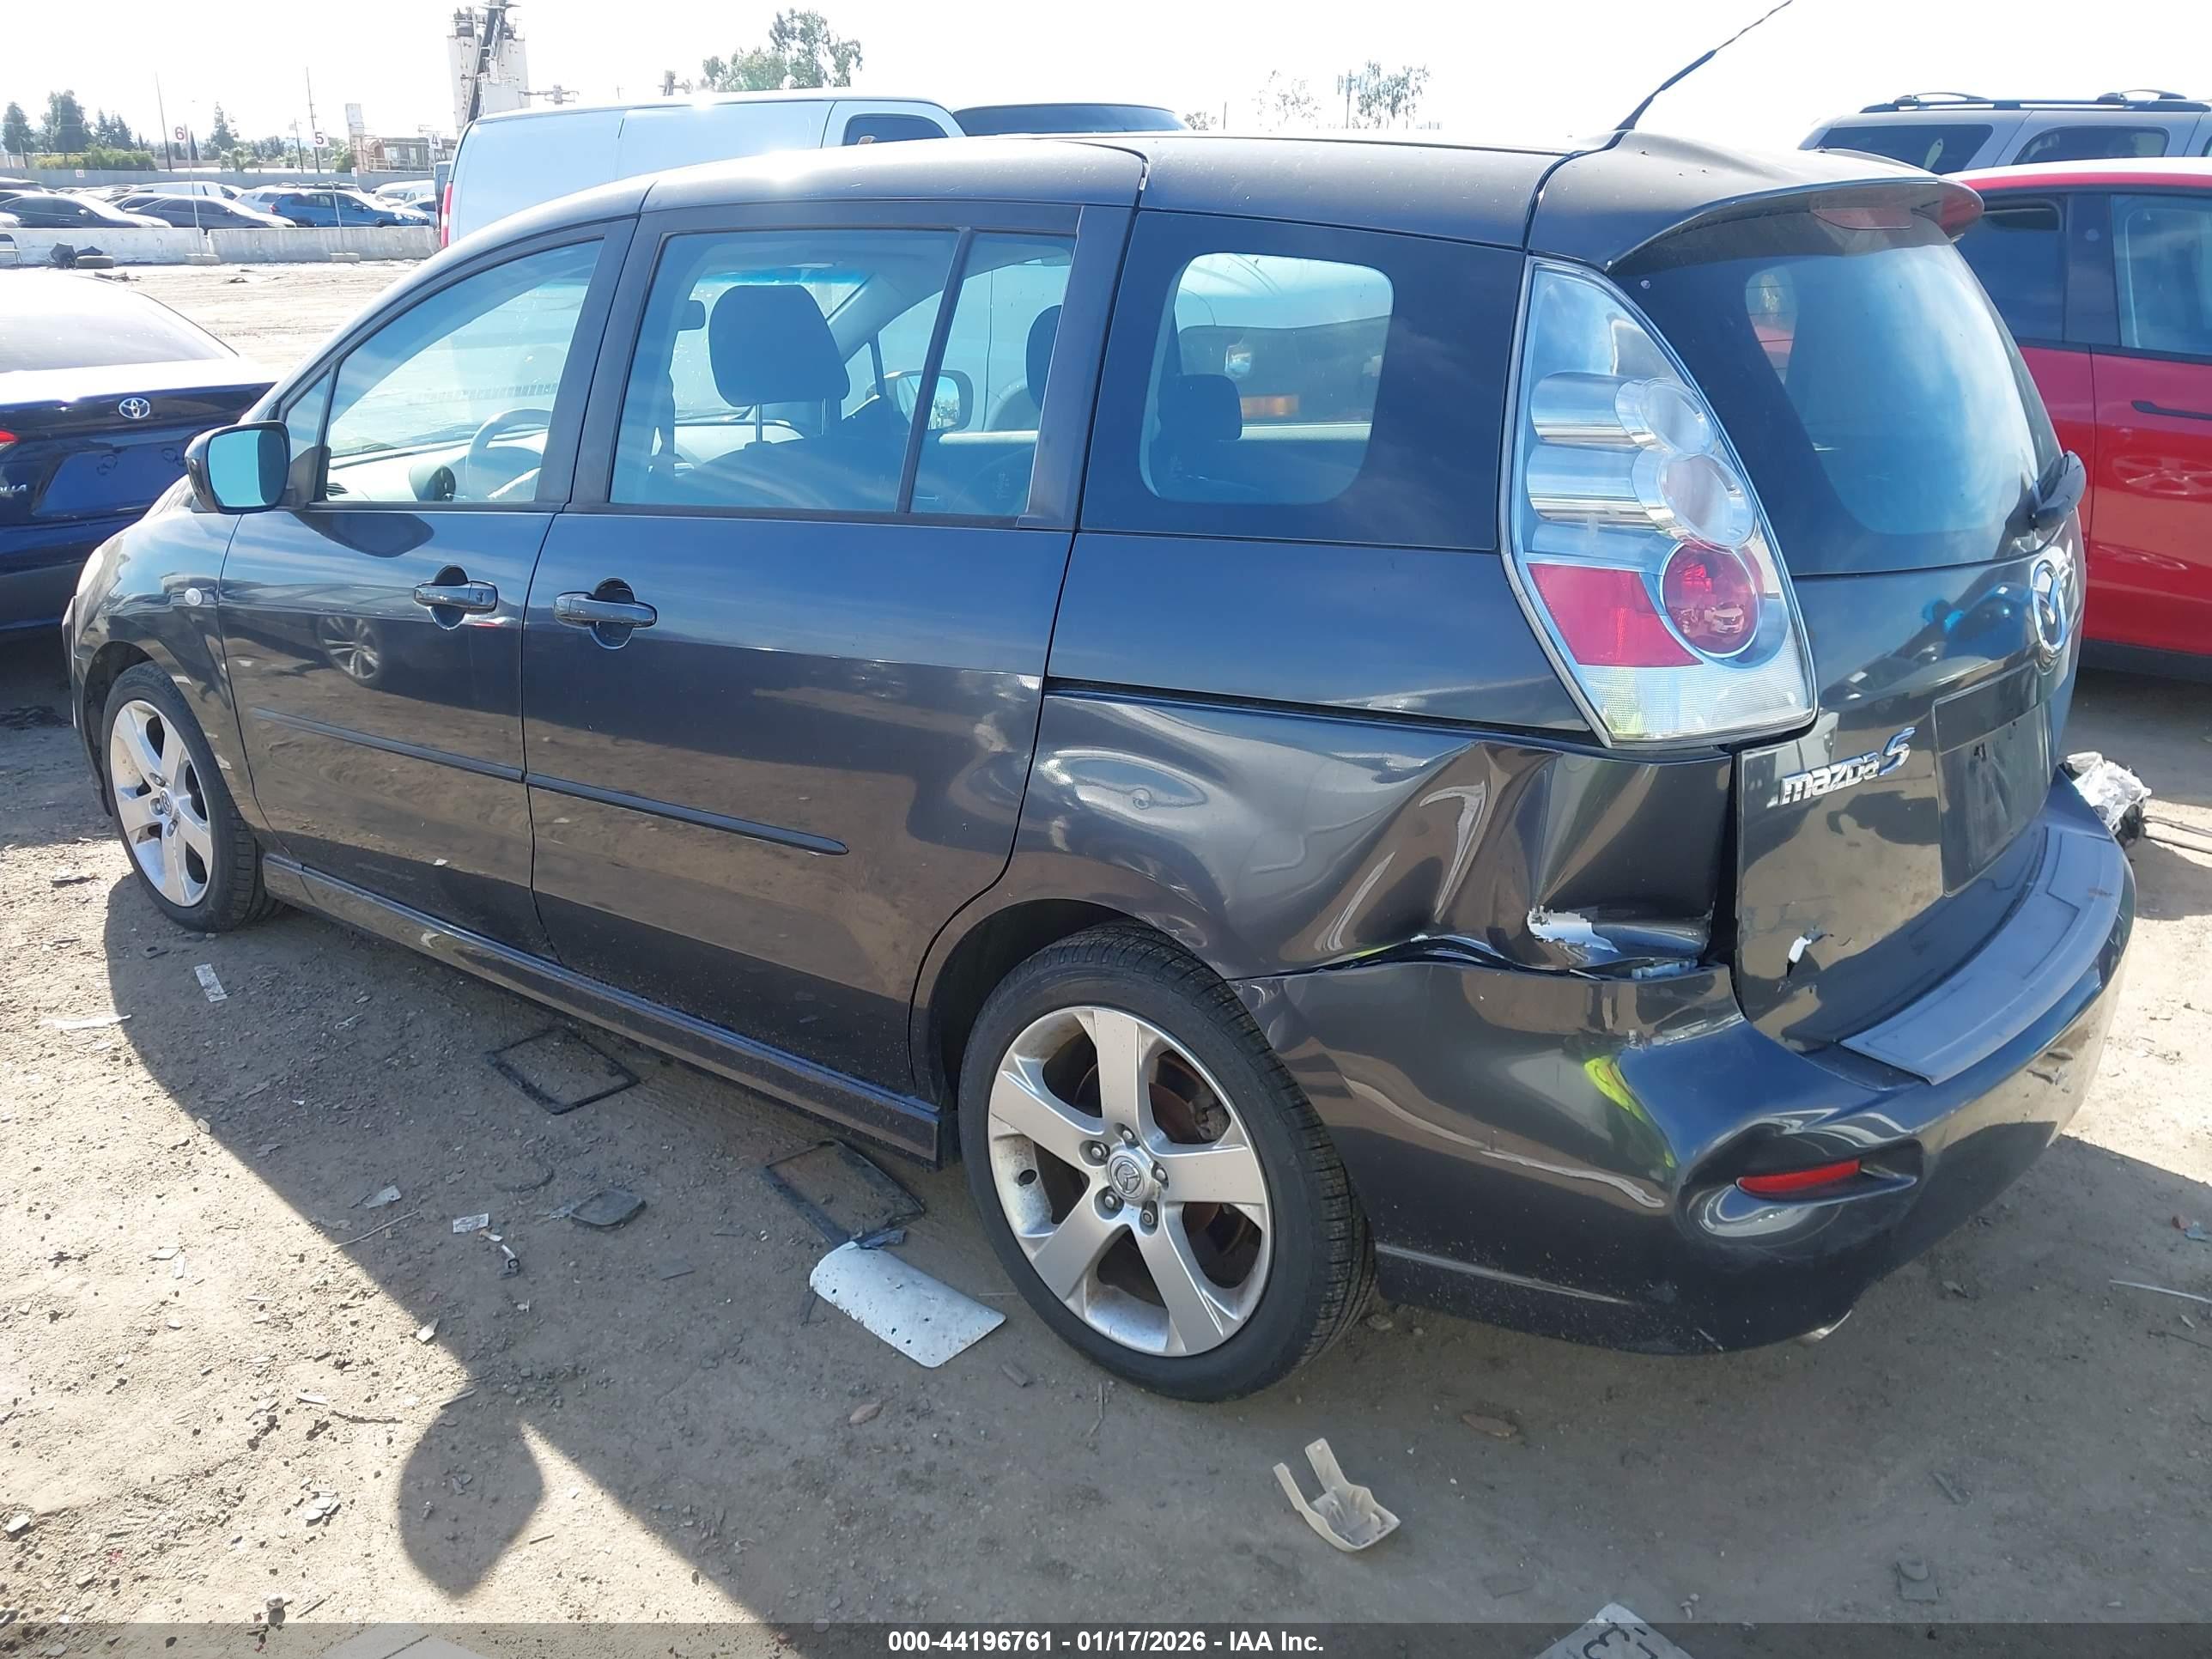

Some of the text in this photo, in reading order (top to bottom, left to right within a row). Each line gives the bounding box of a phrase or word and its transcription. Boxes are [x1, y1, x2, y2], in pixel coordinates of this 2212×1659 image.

[174, 126, 185, 140] 6
[314, 131, 325, 145] 5
[431, 133, 440, 147] 4
